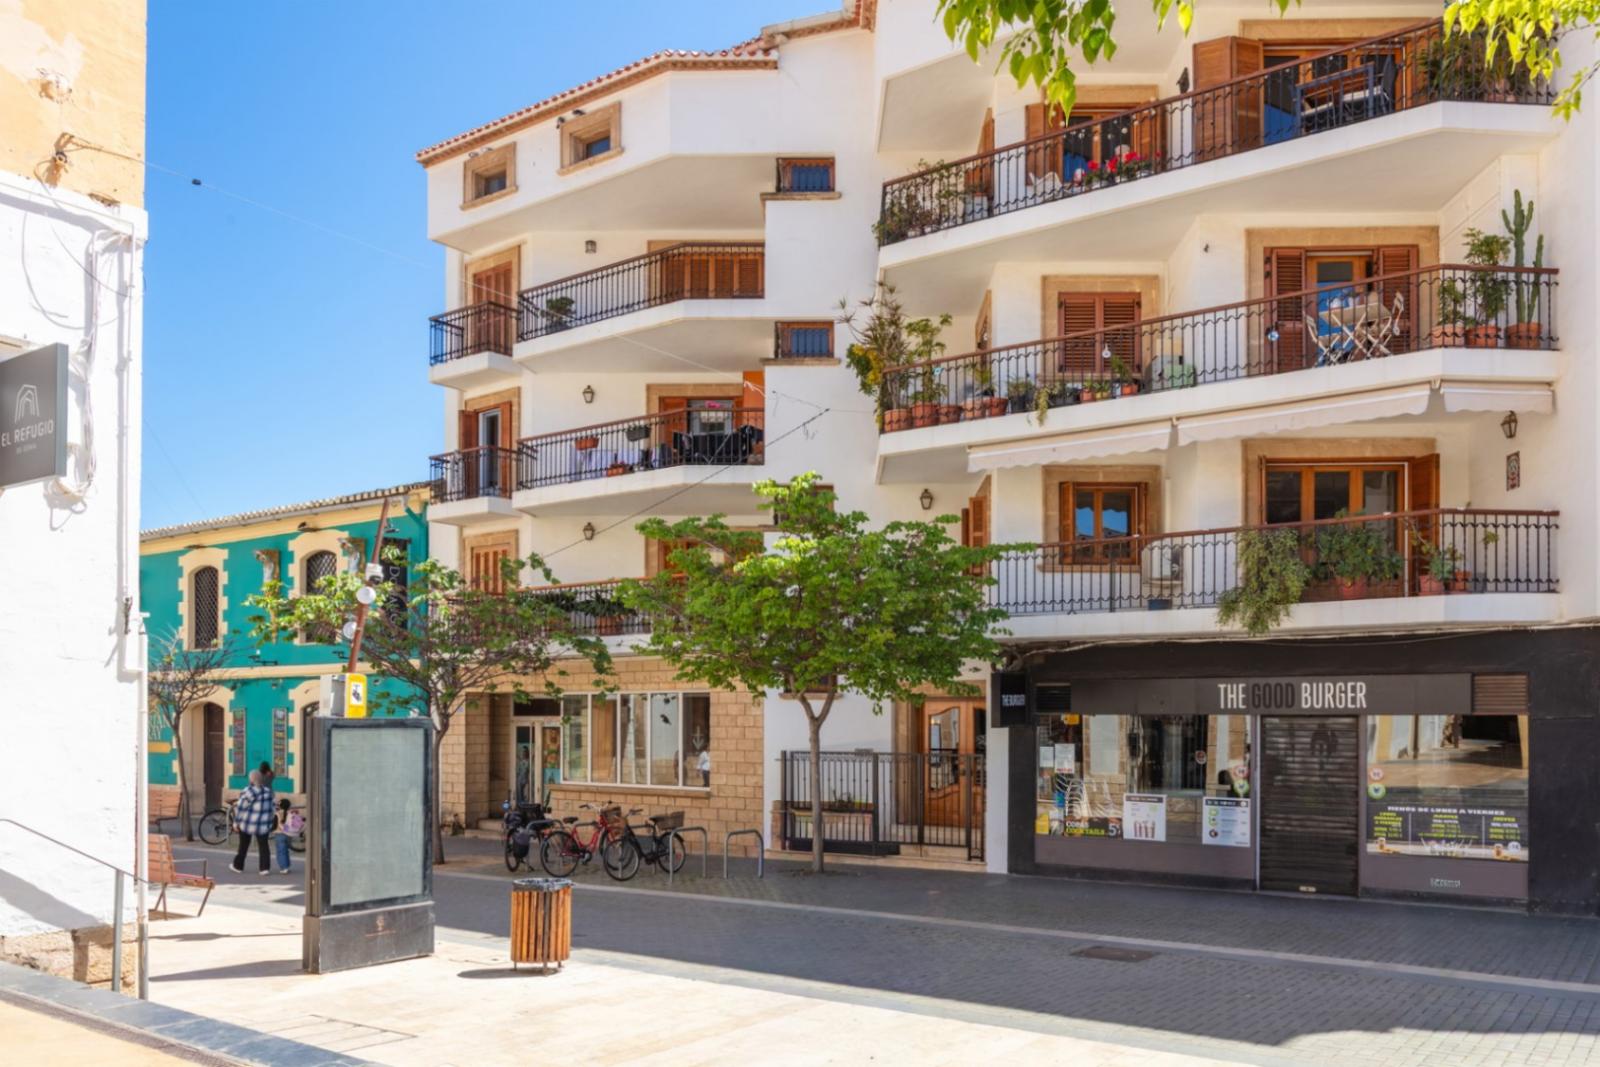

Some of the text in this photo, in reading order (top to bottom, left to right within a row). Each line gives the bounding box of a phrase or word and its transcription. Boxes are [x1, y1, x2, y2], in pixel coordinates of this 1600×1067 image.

[1, 419, 54, 448] EL REFUGIO
[1218, 681, 1367, 709] THE GOOD BURGER
